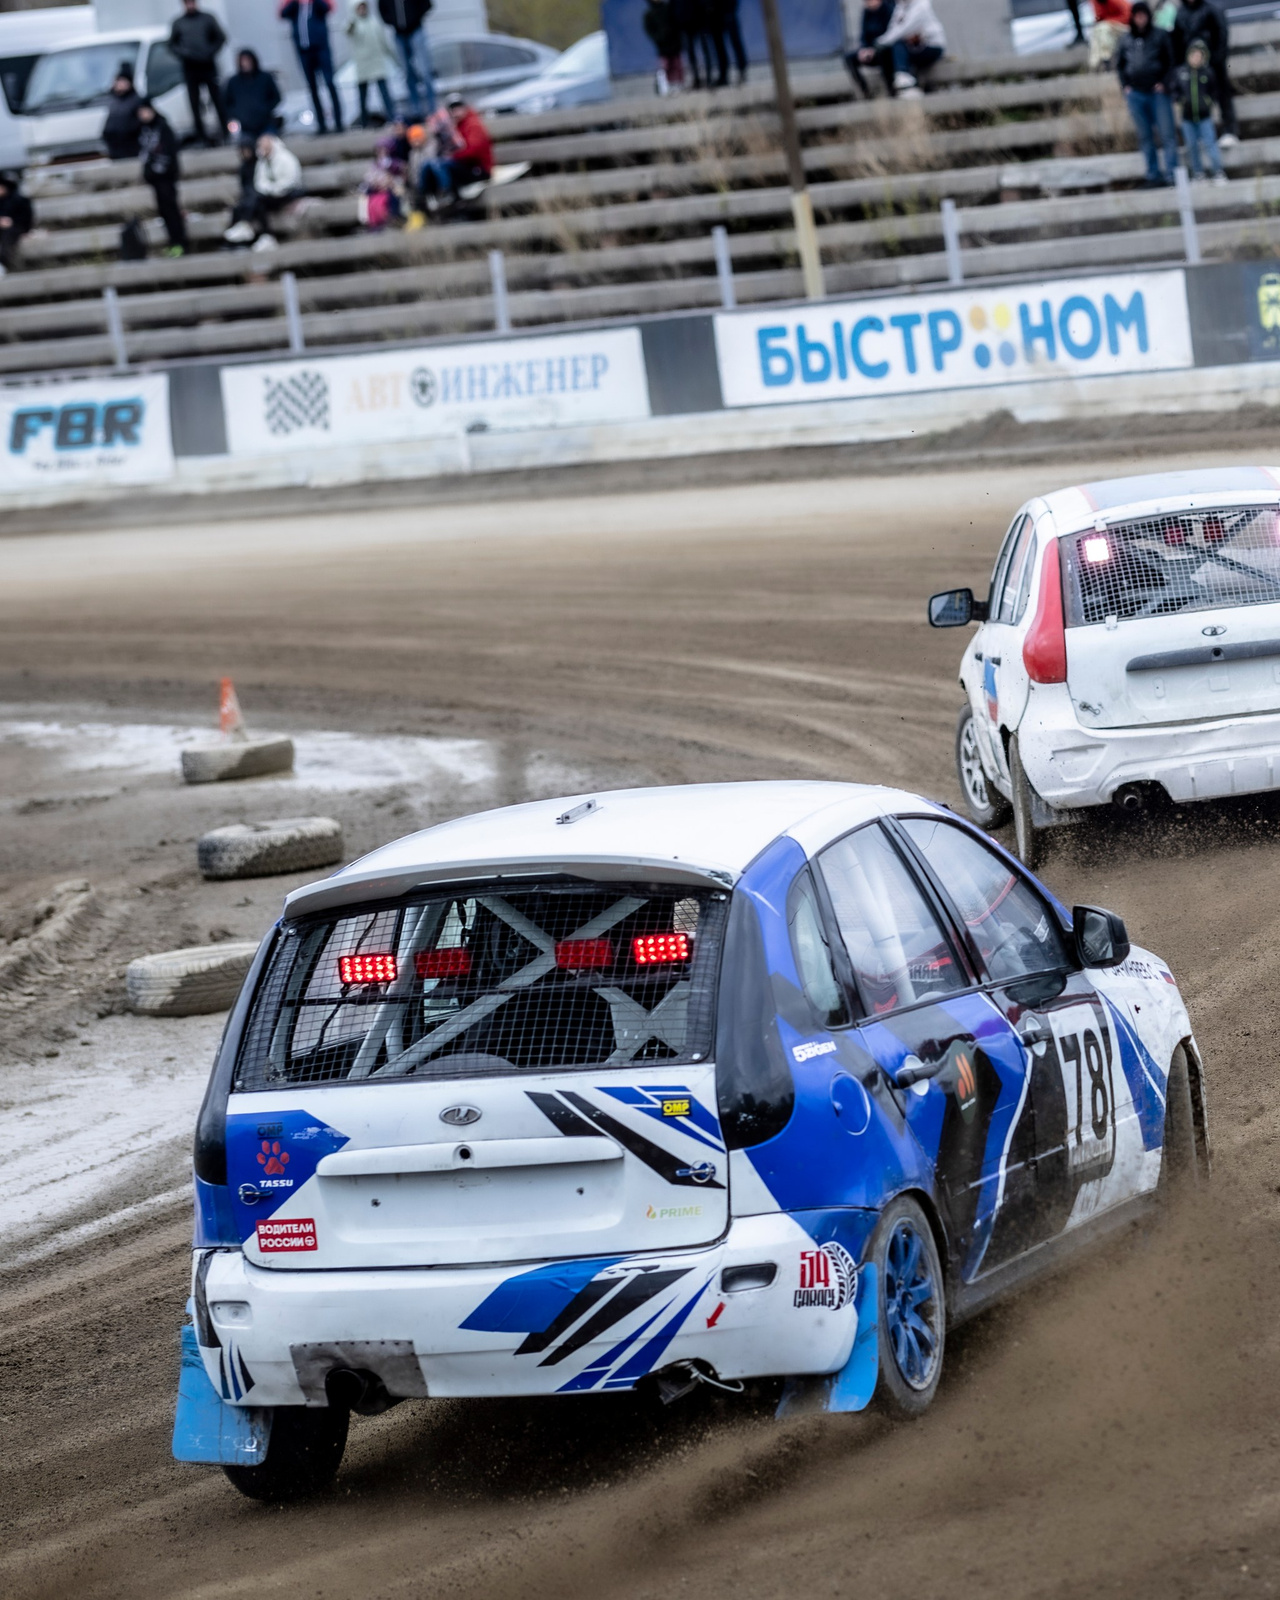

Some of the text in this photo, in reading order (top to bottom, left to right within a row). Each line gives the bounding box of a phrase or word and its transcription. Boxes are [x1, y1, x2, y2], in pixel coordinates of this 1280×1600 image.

[1058, 1027, 1109, 1145] 78
[662, 1101, 690, 1115] OMP
[257, 1124, 283, 1138] OMP
[260, 1180, 294, 1188] TASSU
[660, 1205, 703, 1219] PRIME
[258, 1223, 315, 1235] ВОДИТЕЛИ
[260, 1236, 304, 1248] РОССИИ
[800, 1250, 830, 1289] 54
[793, 1288, 835, 1308] GARAGE
